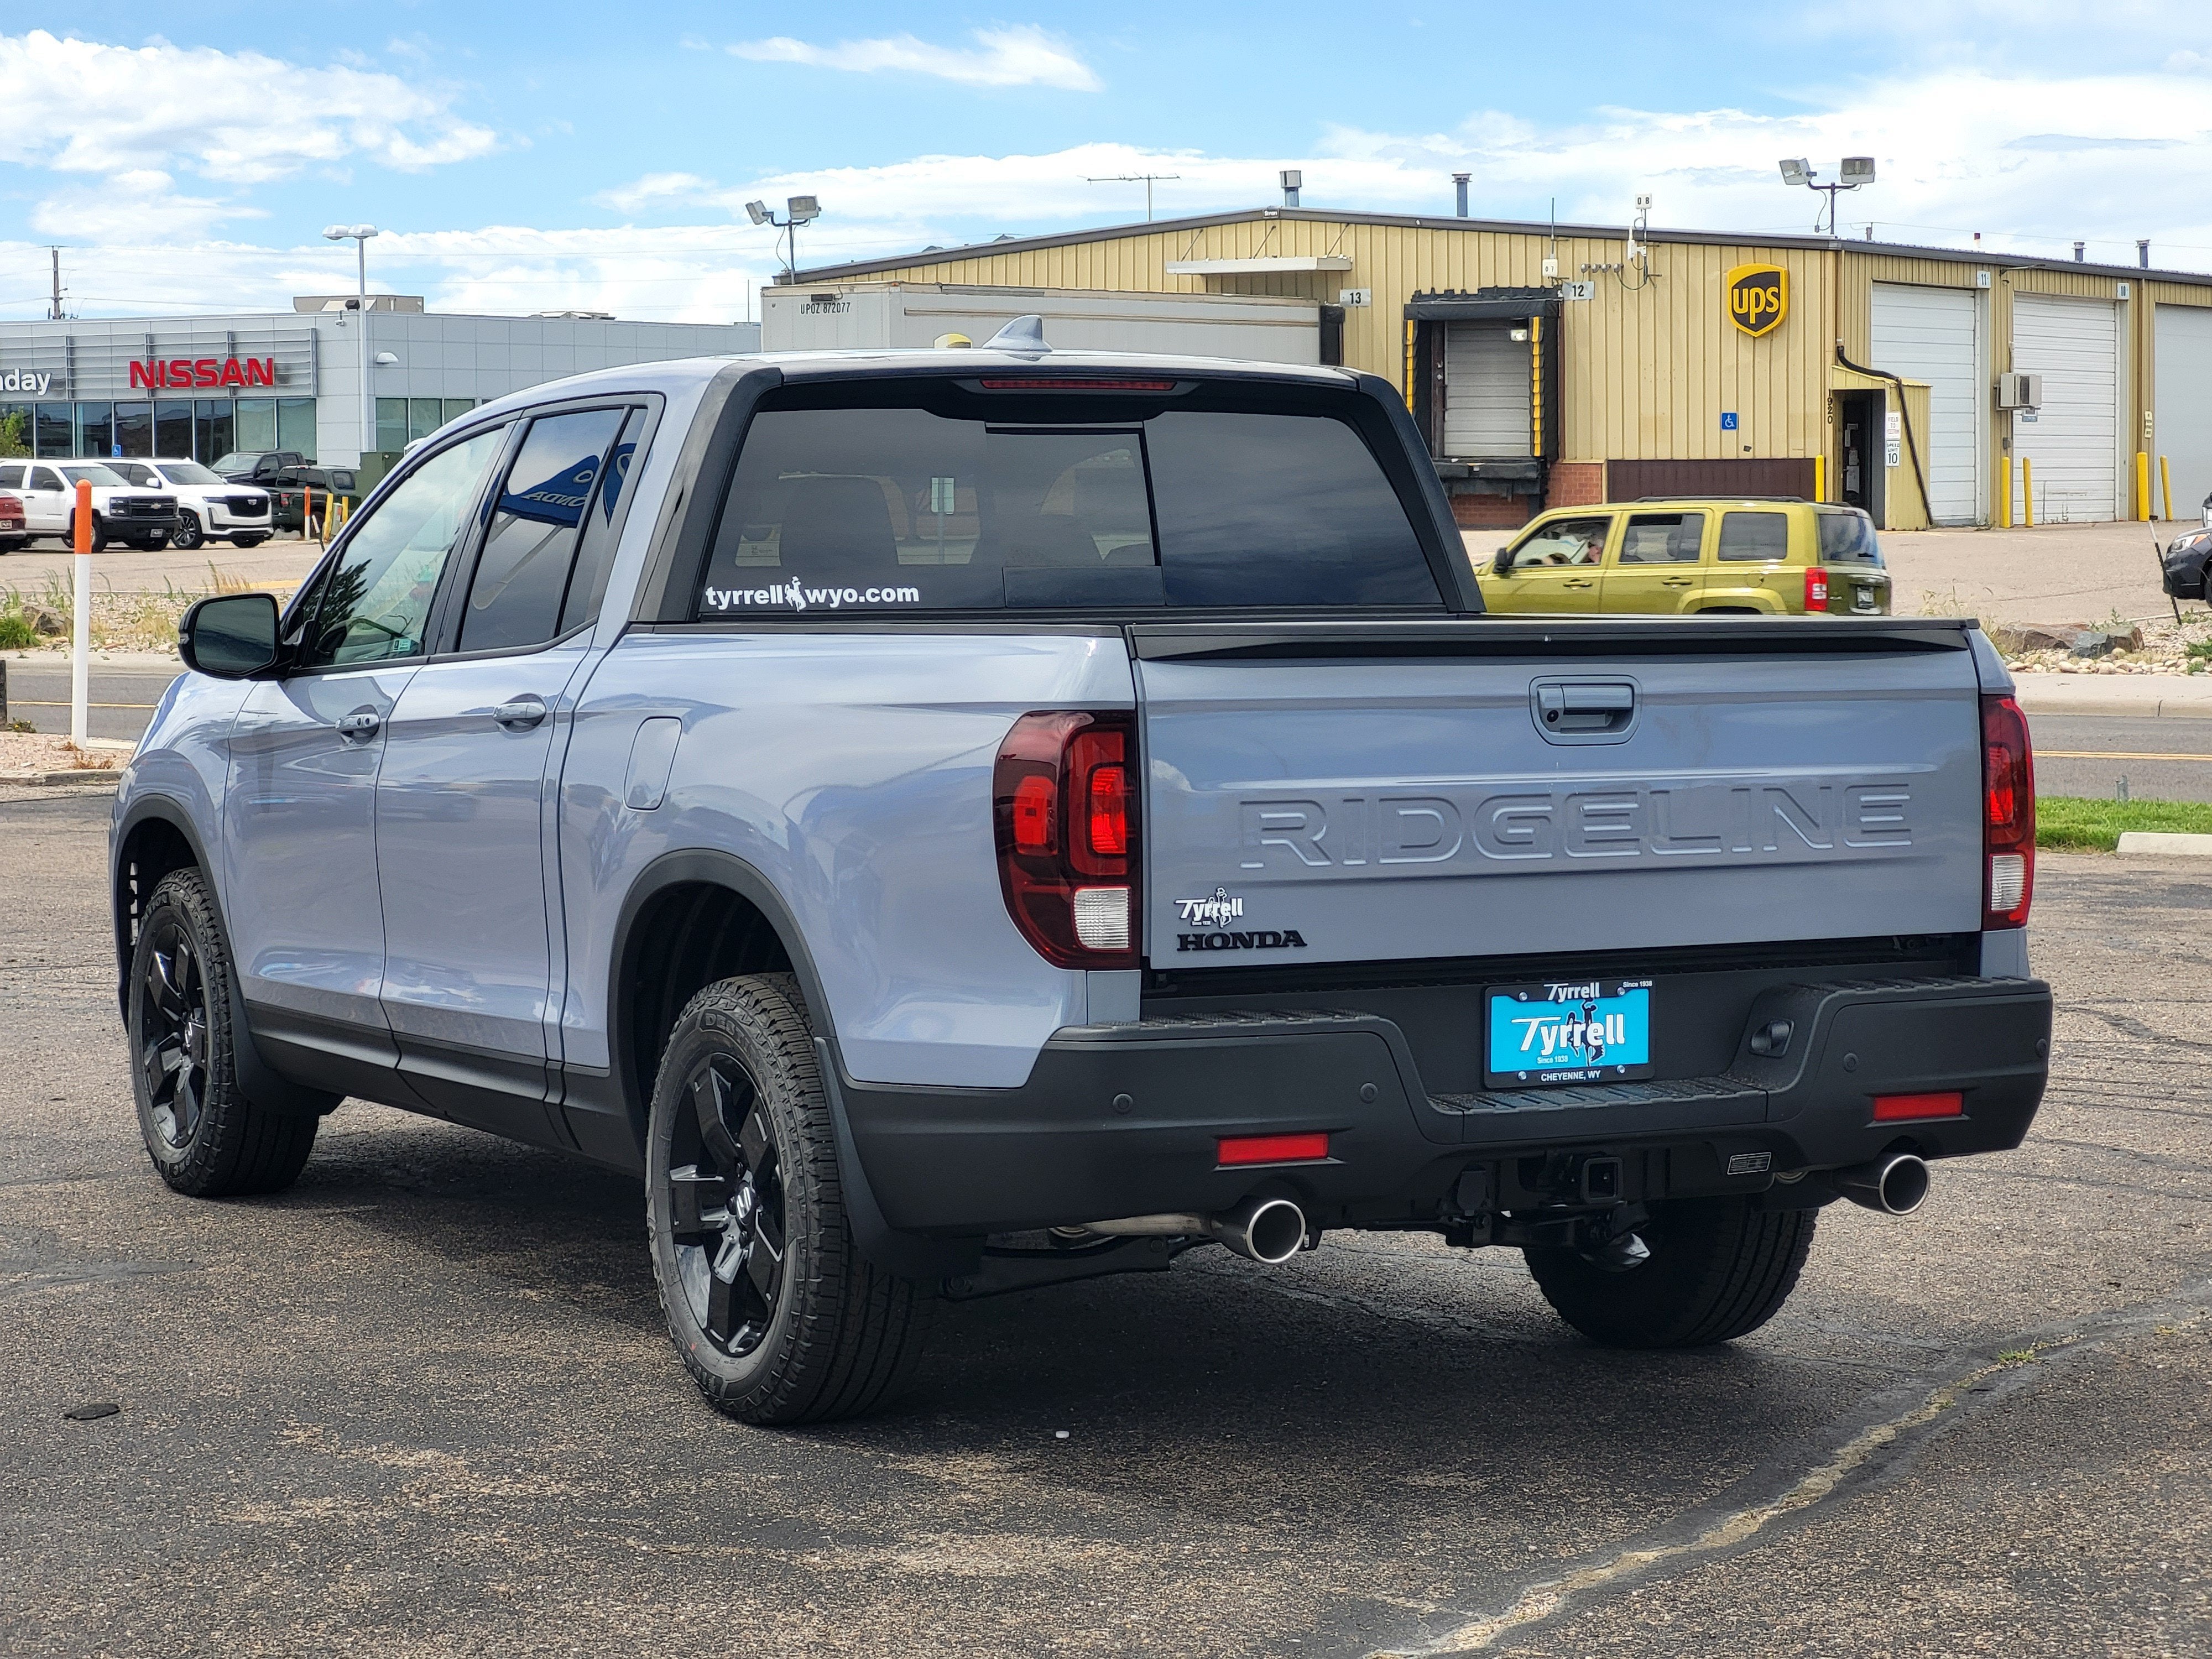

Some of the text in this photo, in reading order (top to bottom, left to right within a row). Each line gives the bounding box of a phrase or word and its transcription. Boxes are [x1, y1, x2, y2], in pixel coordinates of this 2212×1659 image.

[1981, 274, 1987, 285] 11
[1349, 293, 1361, 304] 13
[1572, 285, 1584, 297] 12
[823, 302, 850, 313] 872077
[1733, 287, 1779, 324] ups
[0, 368, 51, 396] day
[129, 358, 274, 388] NISSAN
[1888, 453, 1897, 463] 10
[1240, 784, 1911, 869] RIDGELINE
[1175, 898, 1244, 921] Tyrrell
[1177, 930, 1307, 951] HONDA
[1543, 982, 1600, 1003] Tyrrell
[1511, 1013, 1626, 1056] Tyrrell
[1541, 1070, 1601, 1082] CHEYENNE, WY
